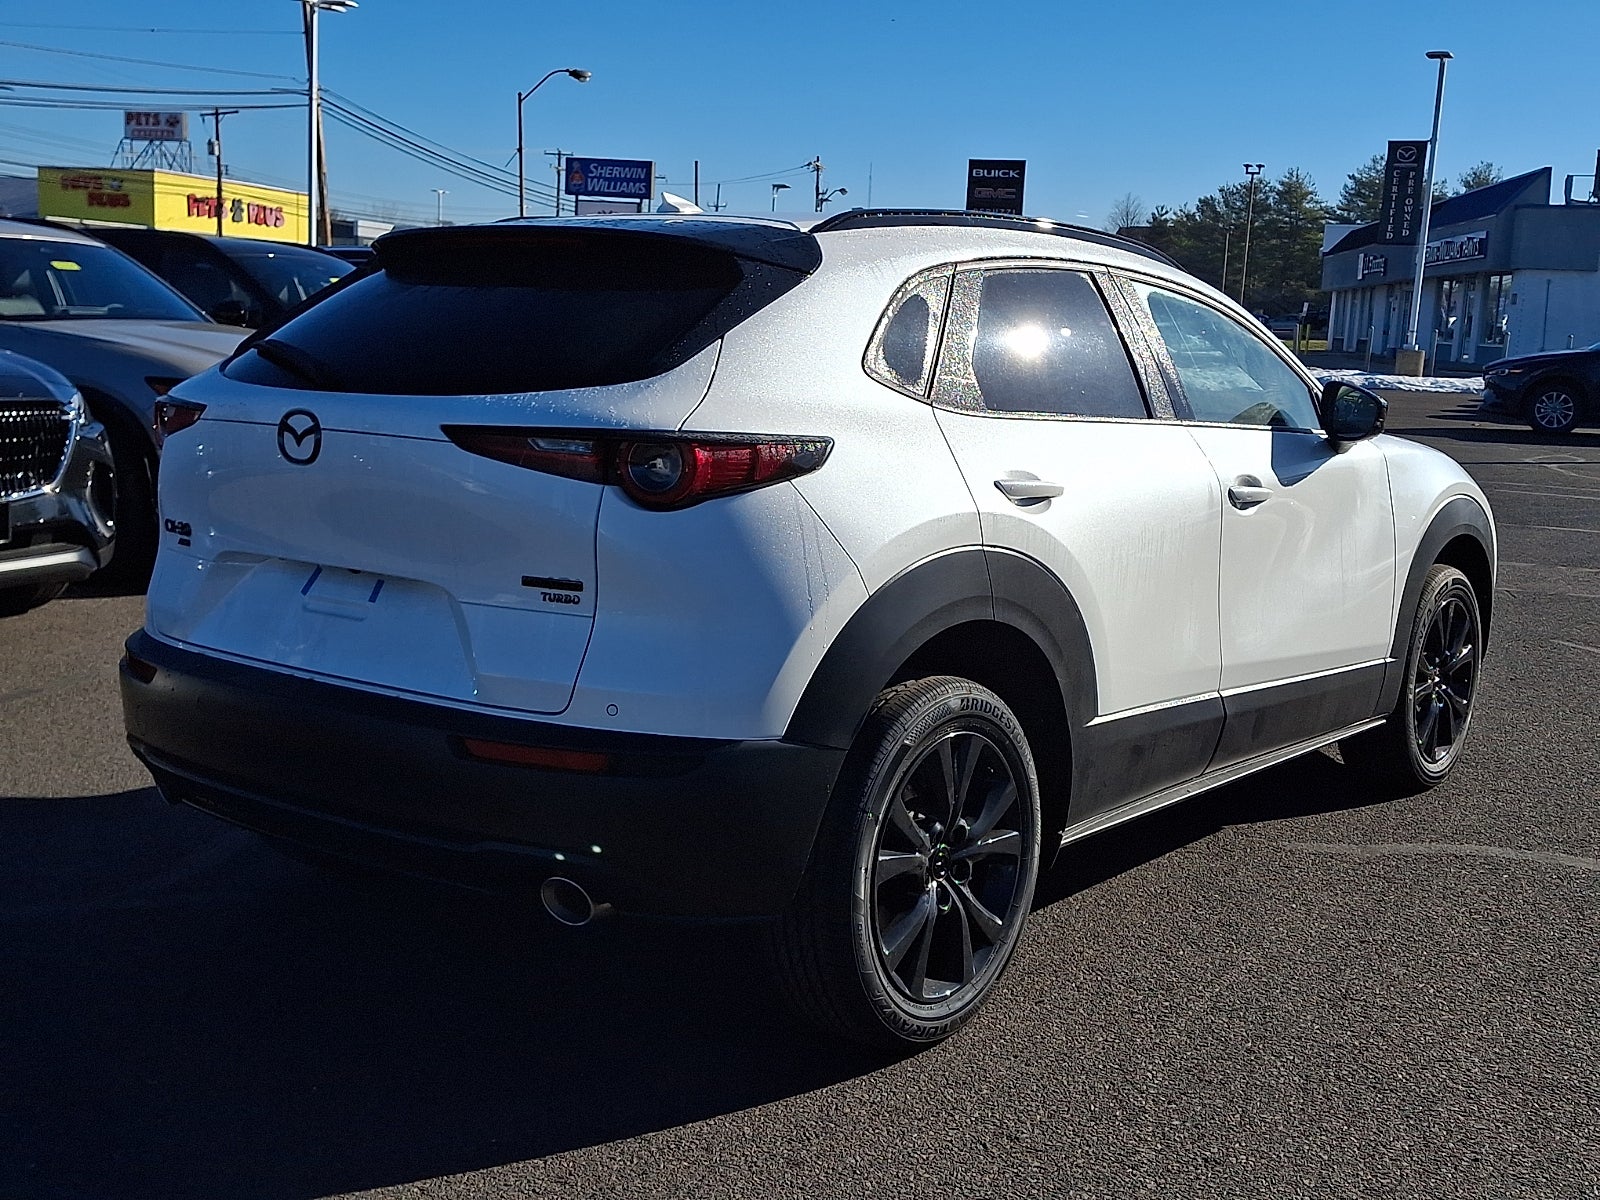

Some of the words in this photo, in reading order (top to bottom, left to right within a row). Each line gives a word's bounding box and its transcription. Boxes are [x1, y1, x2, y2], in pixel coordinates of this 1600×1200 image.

[127, 112, 160, 126] PETS
[588, 163, 646, 179] SHERWIN
[972, 168, 1020, 178] BUICK
[587, 178, 647, 194] WILLIAMS
[1407, 171, 1416, 195] PRE
[974, 187, 1016, 199] GMC
[1386, 170, 1401, 239] CERTIFIED
[247, 202, 285, 227] PLUS
[1402, 197, 1414, 237] OWNED
[541, 592, 581, 605] TURBO
